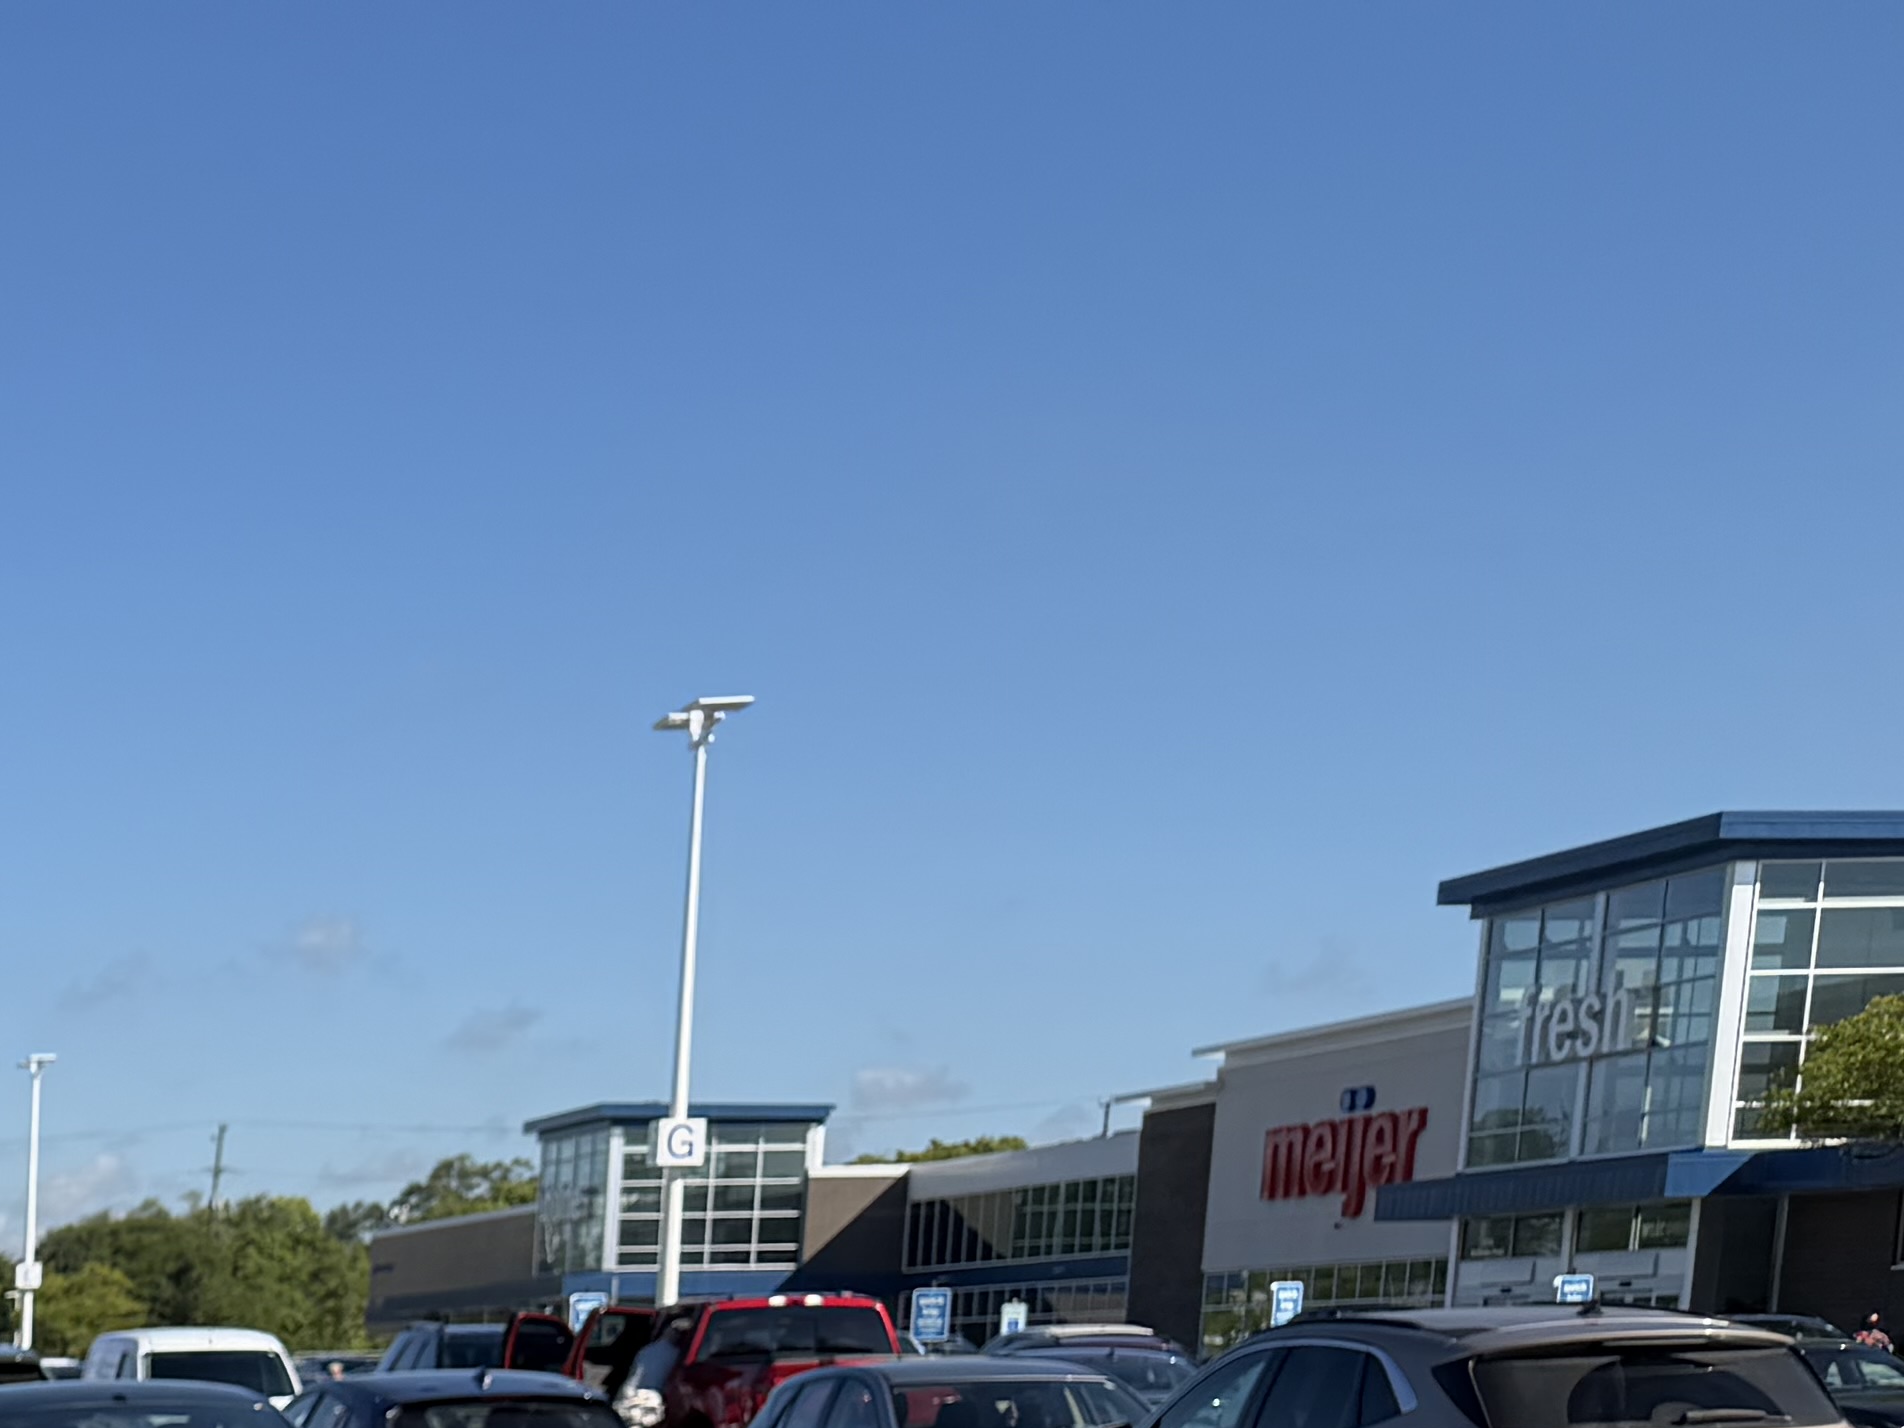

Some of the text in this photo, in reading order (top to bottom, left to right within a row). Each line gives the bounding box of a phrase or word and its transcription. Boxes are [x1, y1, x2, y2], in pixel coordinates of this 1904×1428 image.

[1514, 985, 1632, 1062] fresh
[667, 1123, 694, 1159] G
[1260, 1085, 1429, 1218] meijer
